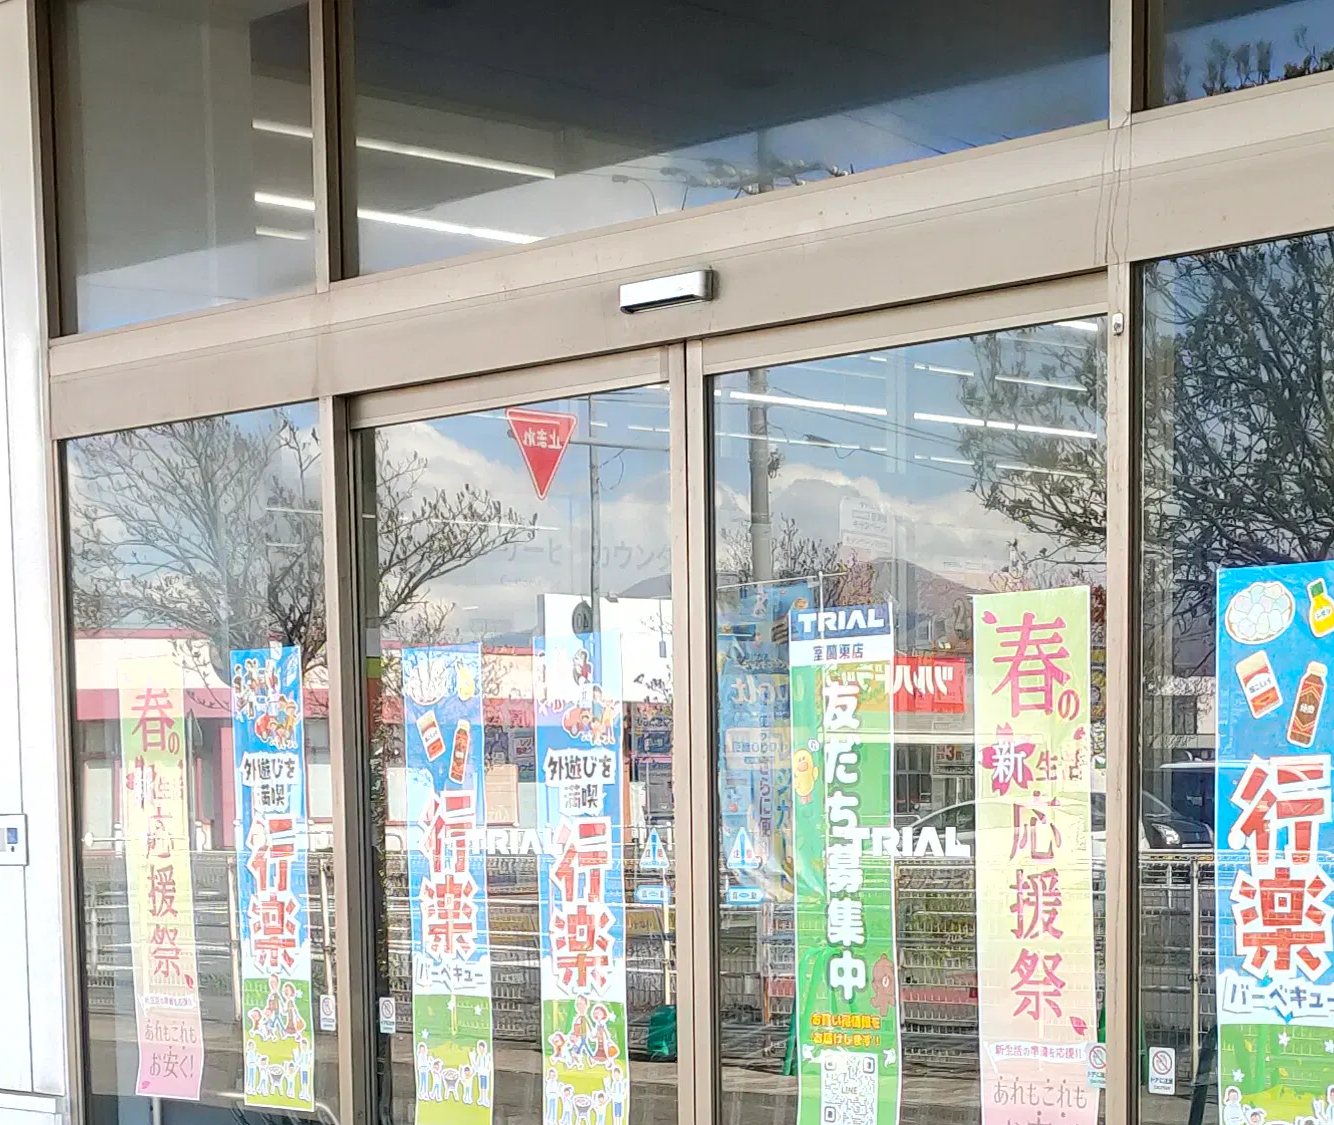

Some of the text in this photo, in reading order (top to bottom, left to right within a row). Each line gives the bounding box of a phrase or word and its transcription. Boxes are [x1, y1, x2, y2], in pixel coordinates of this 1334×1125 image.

[798, 608, 885, 633] TRIAL
[992, 612, 1080, 721] 春の
[132, 686, 180, 755] 春の
[467, 829, 566, 854] TRIAL
[846, 826, 971, 857] TRIAL
[1239, 760, 1328, 970] 行楽
[1010, 791, 1066, 1020] 応援祭
[994, 1080, 1088, 1109] あれもこれも
